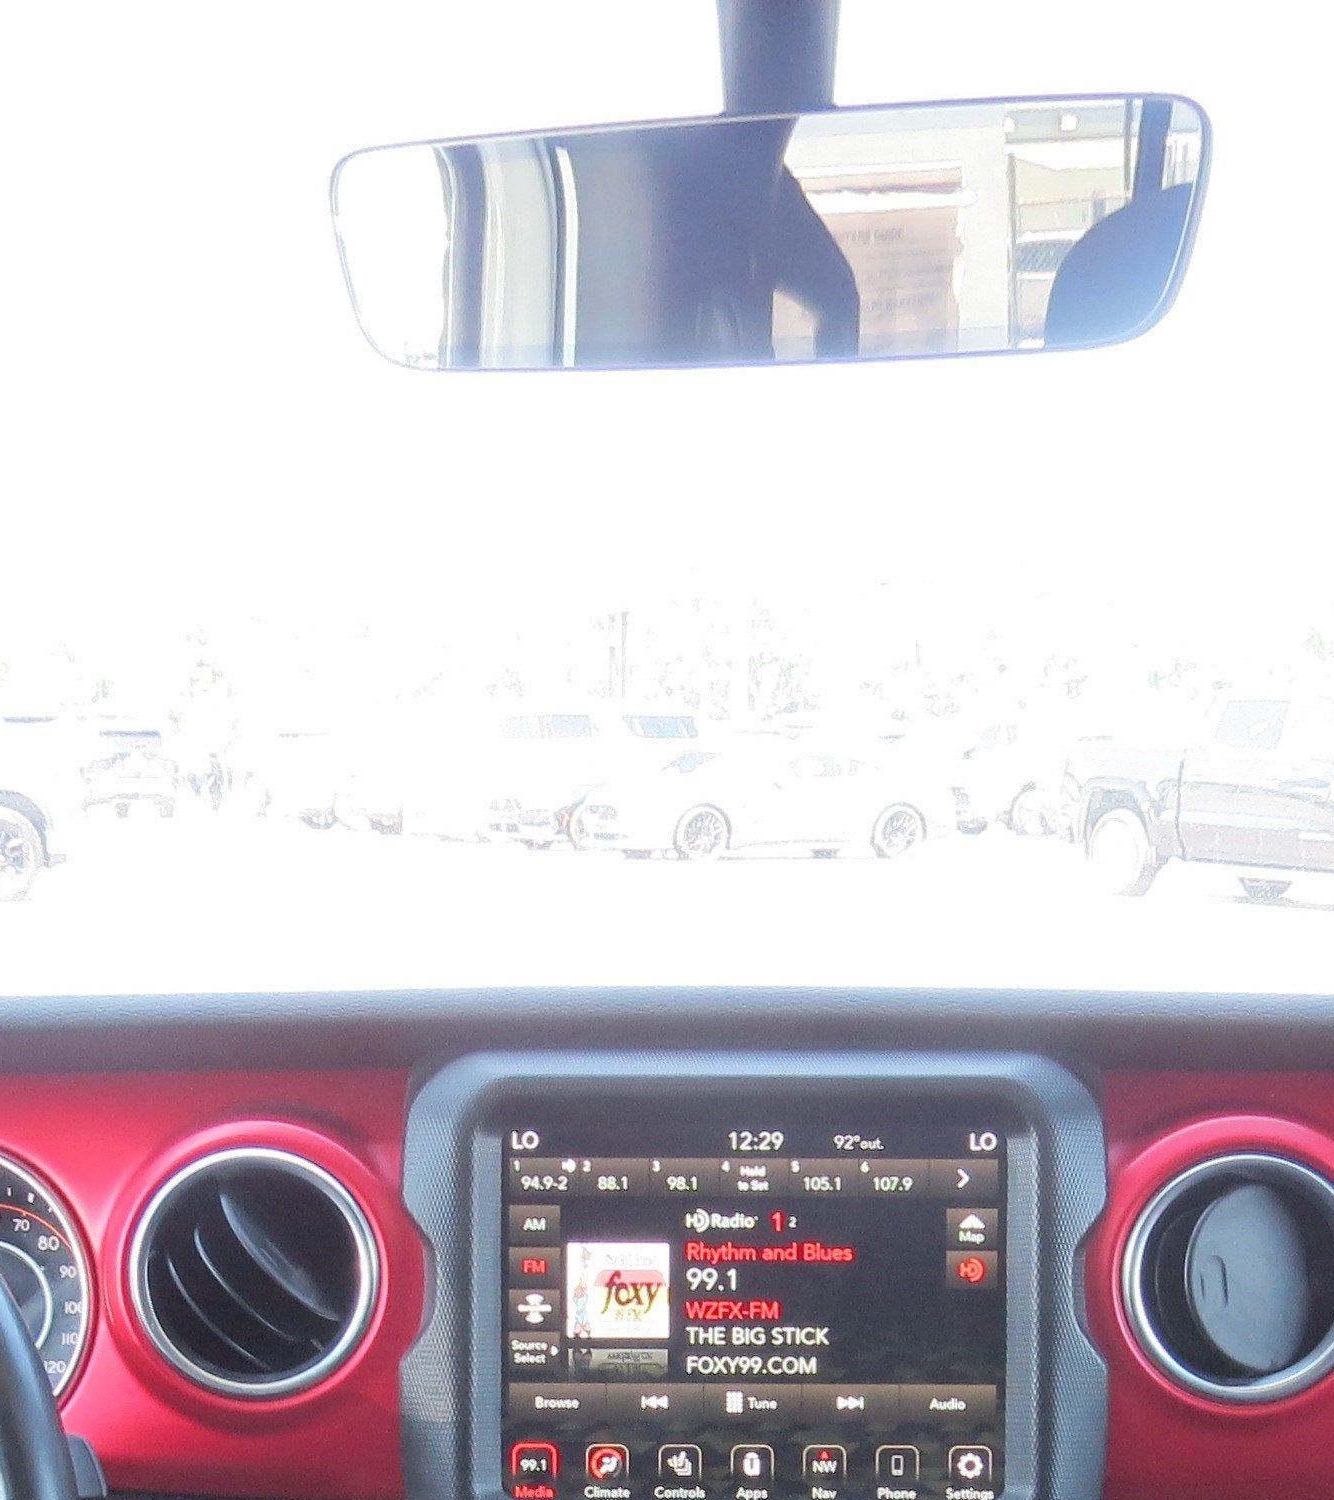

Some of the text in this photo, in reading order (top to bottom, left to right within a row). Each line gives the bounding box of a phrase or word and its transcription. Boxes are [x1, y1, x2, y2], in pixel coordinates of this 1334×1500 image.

[511, 1131, 539, 1150] LO
[728, 1131, 784, 1151] 12:29
[969, 1132, 997, 1151] LO
[581, 1160, 591, 1172] 2
[652, 1160, 661, 1172] 3
[721, 1161, 730, 1172] 4
[740, 1165, 766, 1177] Hold
[521, 1175, 568, 1191] 94.9-2
[597, 1176, 628, 1190] 88.1
[667, 1176, 697, 1190] 98.1
[737, 1180, 770, 1191] to Set
[803, 1177, 842, 1191] 105.1
[873, 1177, 913, 1191] 107.9
[12, 1218, 30, 1232] 70
[523, 1217, 546, 1231] AM
[711, 1212, 756, 1229] Radio
[788, 1216, 797, 1228] 2
[37, 1235, 60, 1251] 80
[958, 1231, 985, 1244] Map
[686, 1241, 854, 1264] Rhythm and Blues
[59, 1266, 77, 1278] 90
[523, 1260, 546, 1274] FM
[685, 1267, 737, 1291] 99.1
[685, 1301, 780, 1320] WZFX-FM
[61, 1333, 78, 1345] 110
[685, 1327, 829, 1346] THE BIG STICK
[511, 1339, 548, 1351] Source
[514, 1352, 546, 1364] Select
[686, 1356, 818, 1375] FOXY99.COM
[535, 1395, 580, 1409] Browse
[747, 1397, 778, 1410] Tune
[929, 1397, 966, 1411] Audio
[520, 1458, 548, 1472] 99.1
[812, 1461, 837, 1474] NW
[515, 1485, 554, 1499] Media
[584, 1486, 631, 1499] Climate
[654, 1486, 706, 1500] Controls
[735, 1487, 768, 1500] Apps
[811, 1487, 837, 1500] Nav
[877, 1487, 917, 1500] Phone
[946, 1487, 995, 1500] Settings
